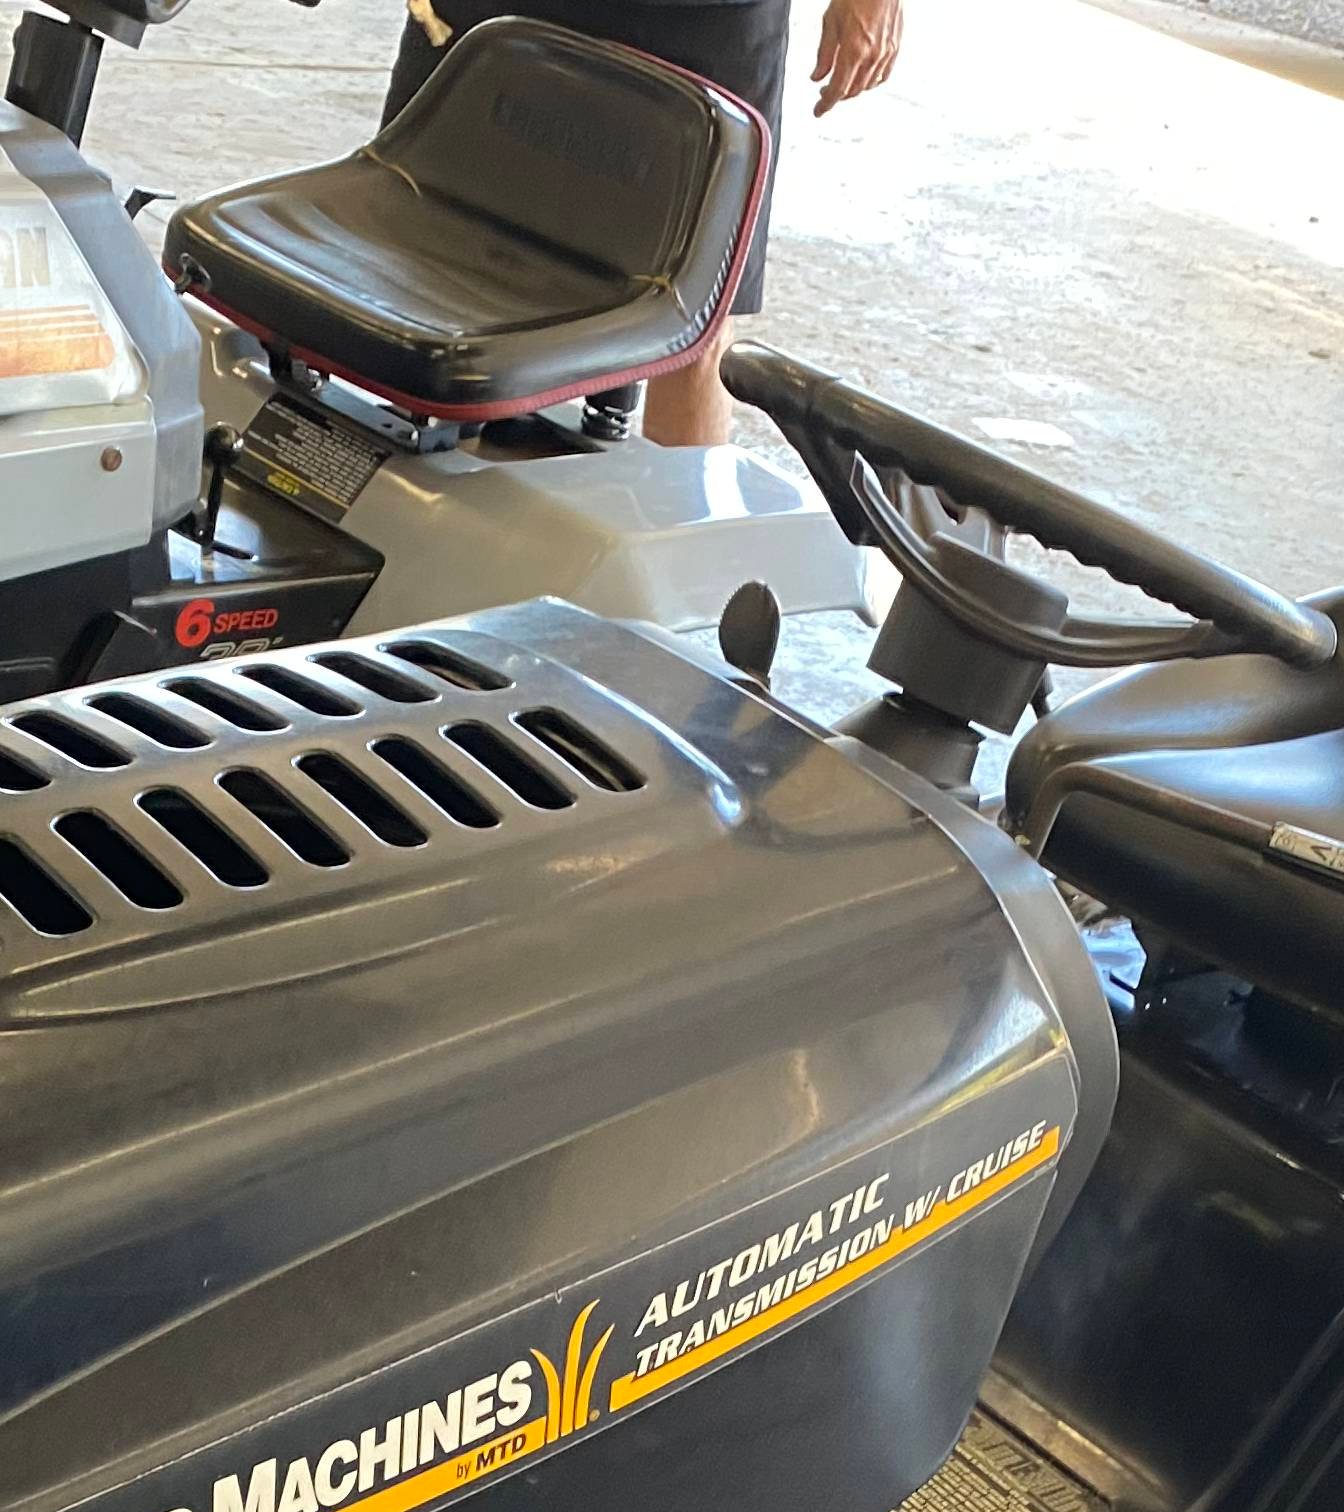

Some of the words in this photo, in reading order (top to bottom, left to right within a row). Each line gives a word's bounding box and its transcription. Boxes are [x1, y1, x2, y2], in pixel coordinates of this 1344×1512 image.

[176, 598, 214, 648] 6
[214, 608, 278, 633] SPEED
[634, 1214, 895, 1378] TRANSMISSION
[902, 1186, 941, 1230] W/
[945, 1120, 1047, 1203] CRUISE
[634, 1173, 890, 1337] AUTOMATIC
[456, 1461, 471, 1480] by
[475, 1433, 527, 1472] MTD
